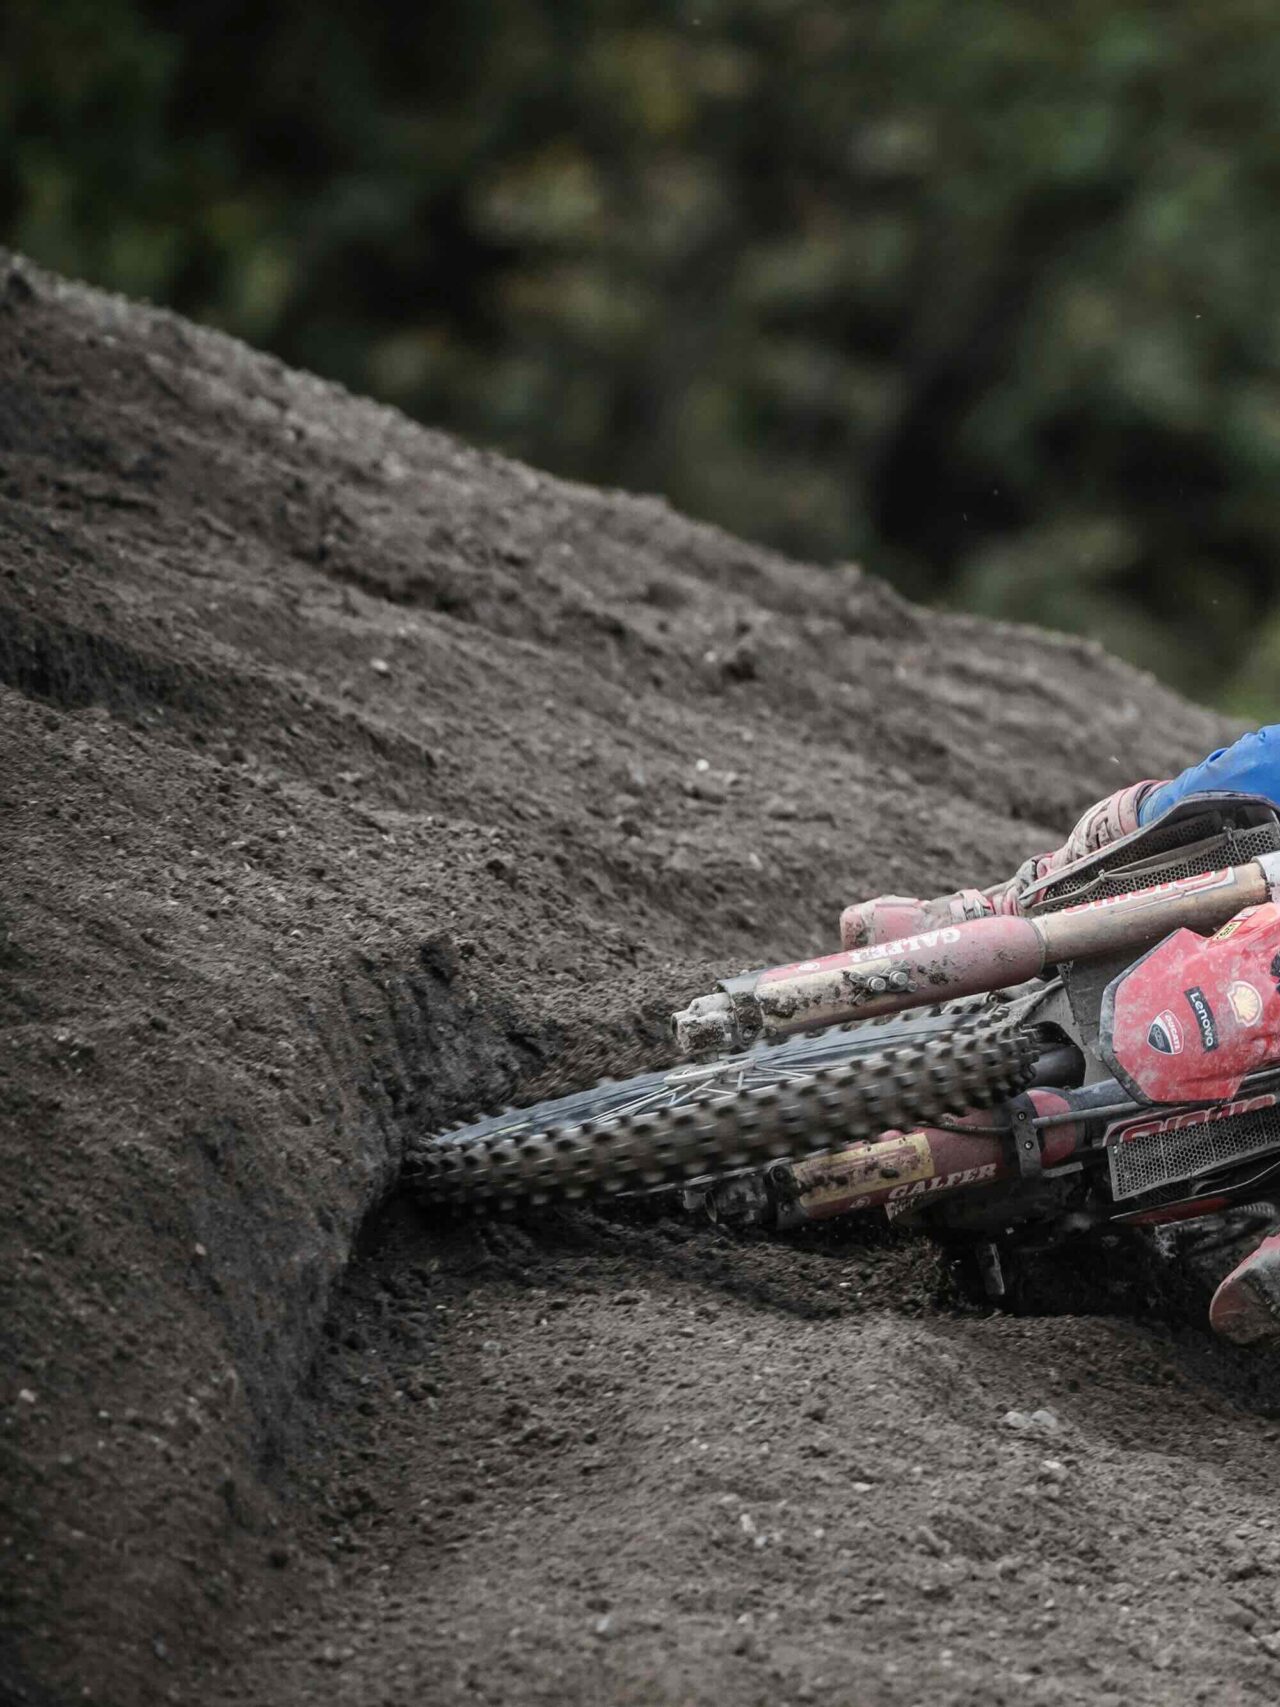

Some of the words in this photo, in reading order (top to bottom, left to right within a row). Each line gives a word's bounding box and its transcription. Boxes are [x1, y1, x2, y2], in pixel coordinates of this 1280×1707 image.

[852, 926, 961, 963] GALFER
[1164, 1014, 1180, 1050] DUCATI
[1190, 992, 1214, 1047] Lenovo
[888, 1163, 997, 1200] GALFER
